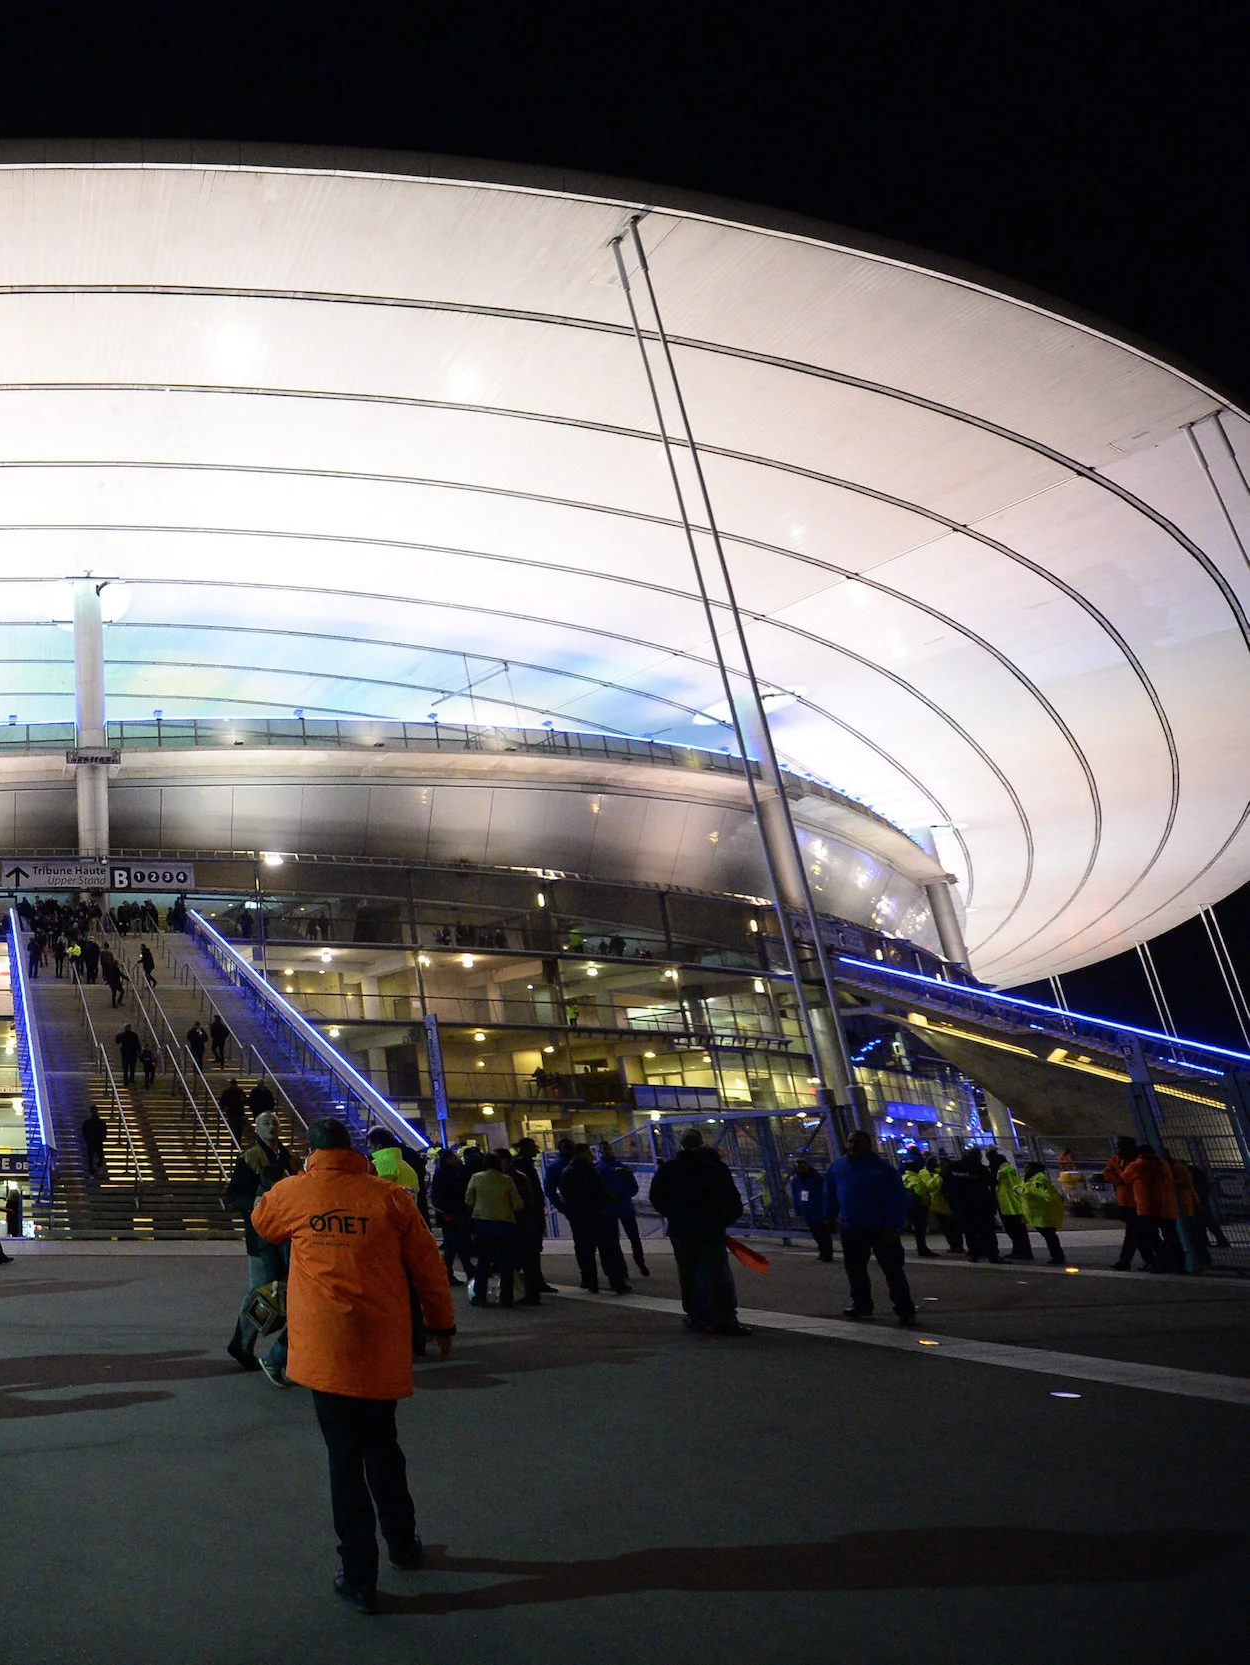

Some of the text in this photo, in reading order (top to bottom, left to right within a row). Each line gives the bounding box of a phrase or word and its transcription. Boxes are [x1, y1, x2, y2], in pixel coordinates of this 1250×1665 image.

[32, 866, 106, 875] Tribune Haute
[47, 876, 106, 886] Upper Stand
[114, 870, 128, 888] B
[16, 1162, 29, 1170] DE
[310, 1211, 369, 1236] ONET
